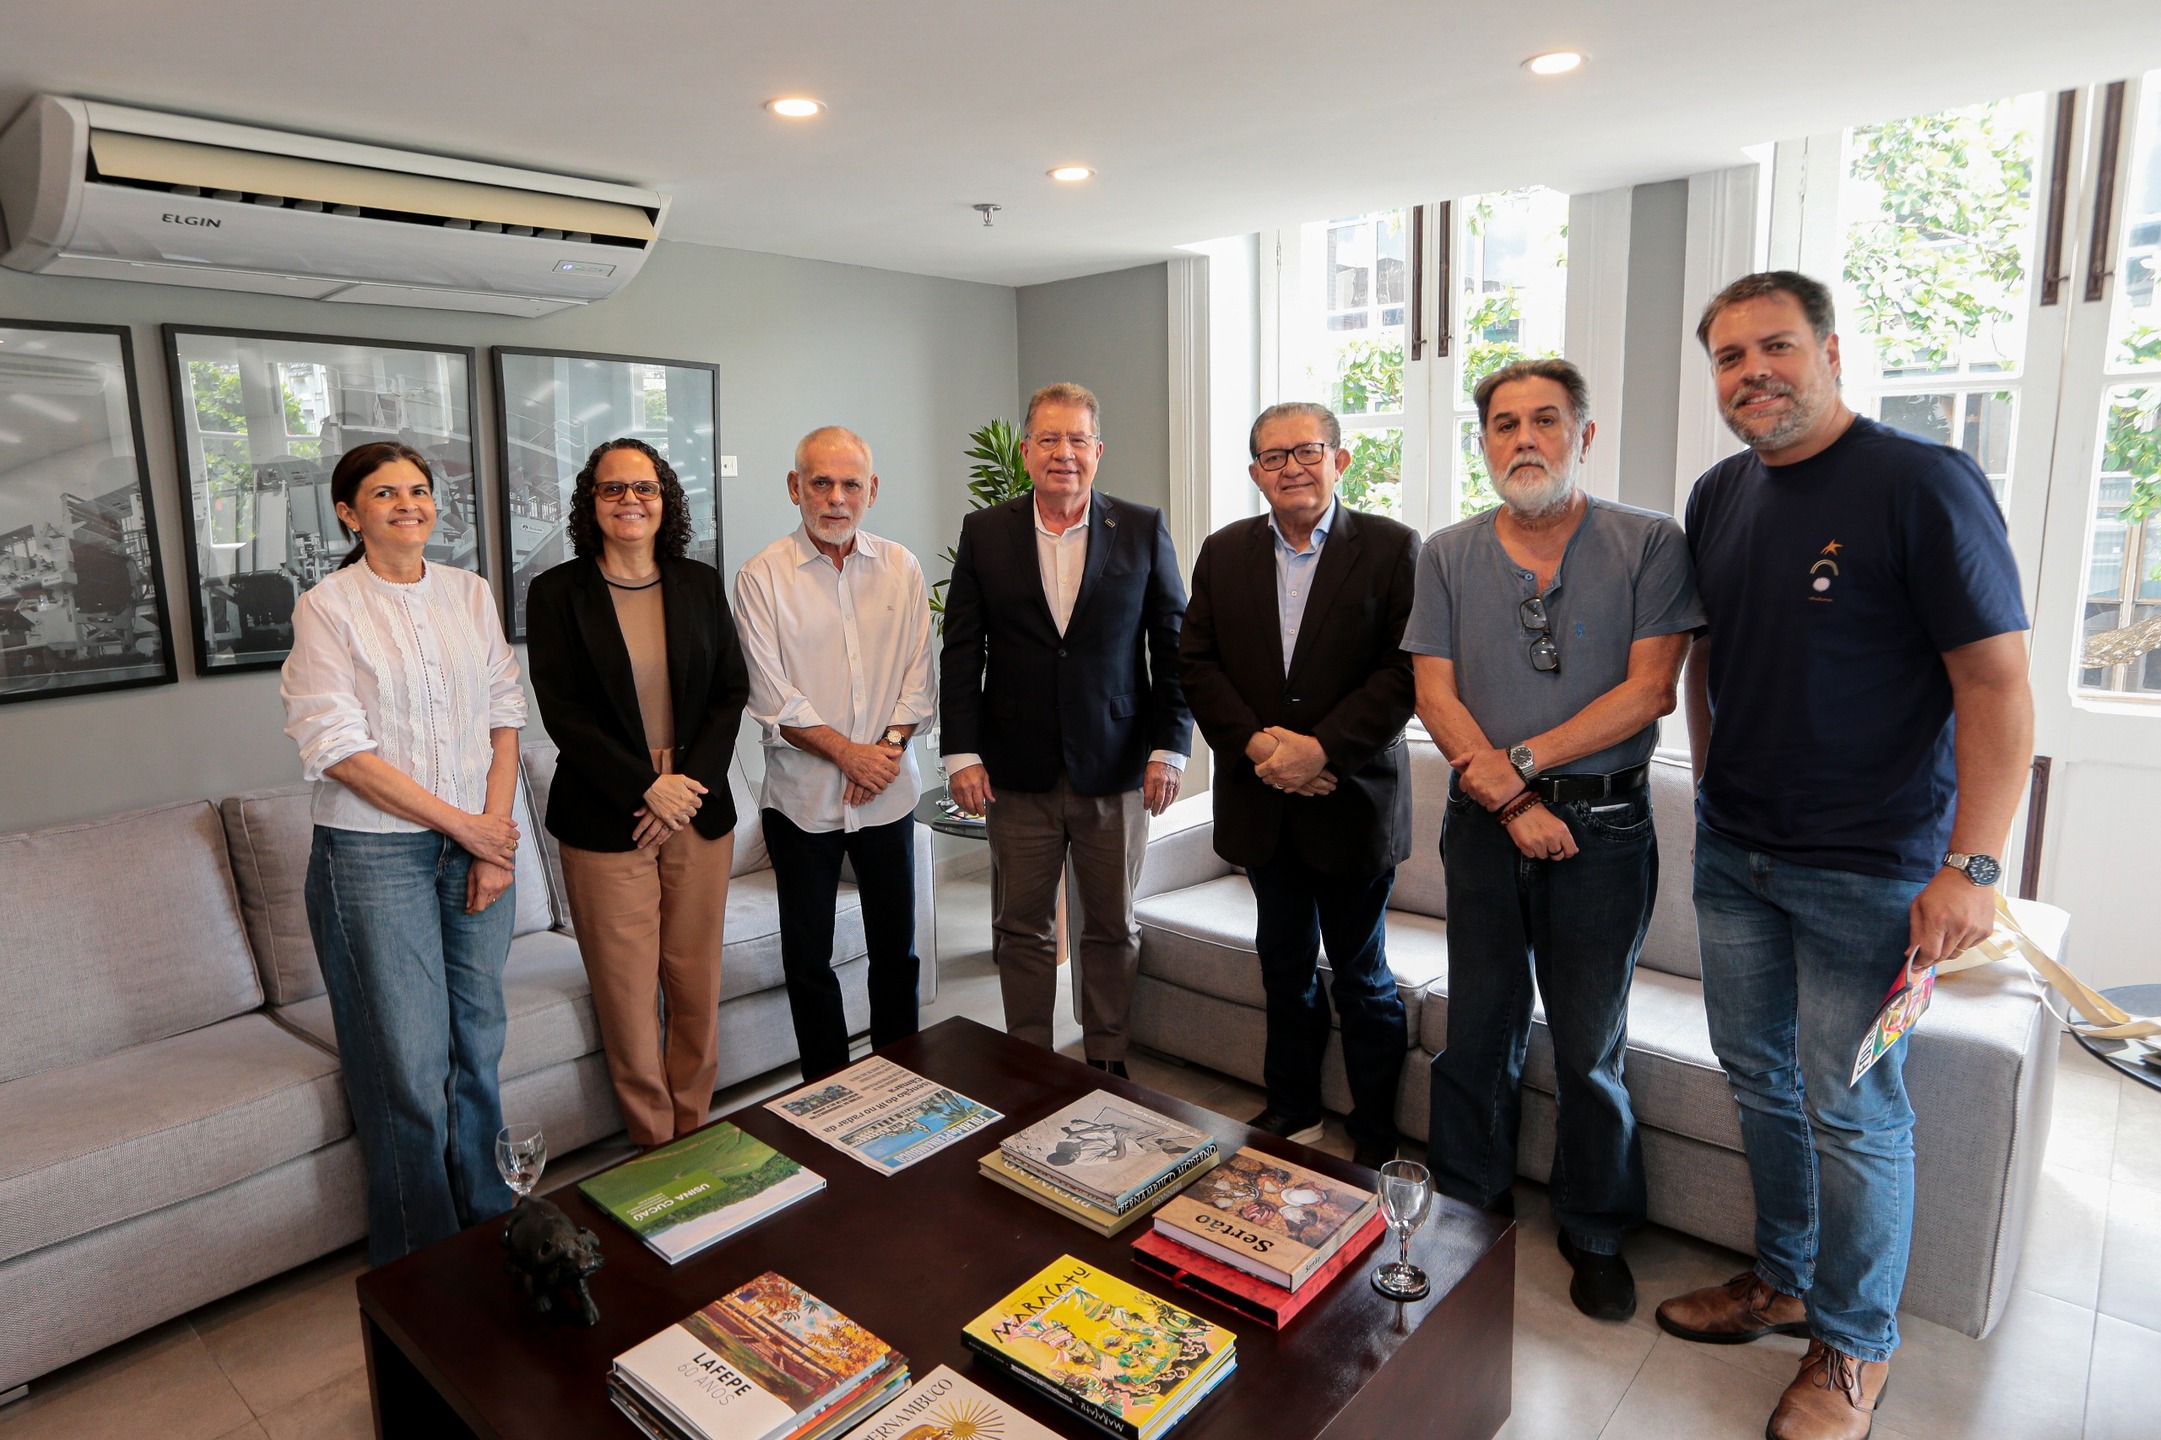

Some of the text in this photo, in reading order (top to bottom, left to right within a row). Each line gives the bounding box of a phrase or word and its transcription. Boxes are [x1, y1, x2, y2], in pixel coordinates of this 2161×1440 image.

[162, 213, 221, 228] ELGIN
[888, 1077, 923, 1093] Câmara
[899, 1081, 933, 1098] Isenção
[838, 1112, 865, 1128] radar
[1118, 1173, 1175, 1217] PERNAMBUCO
[1177, 1144, 1217, 1176] MODERNO
[675, 1183, 710, 1201] USINA
[633, 1200, 674, 1222] CUCAÚ
[1195, 1213, 1275, 1253] Sertão
[678, 1362, 735, 1405] 60 ANOS
[693, 1352, 752, 1396] LAFEPE
[864, 1379, 952, 1440] ERNAMBUCO
